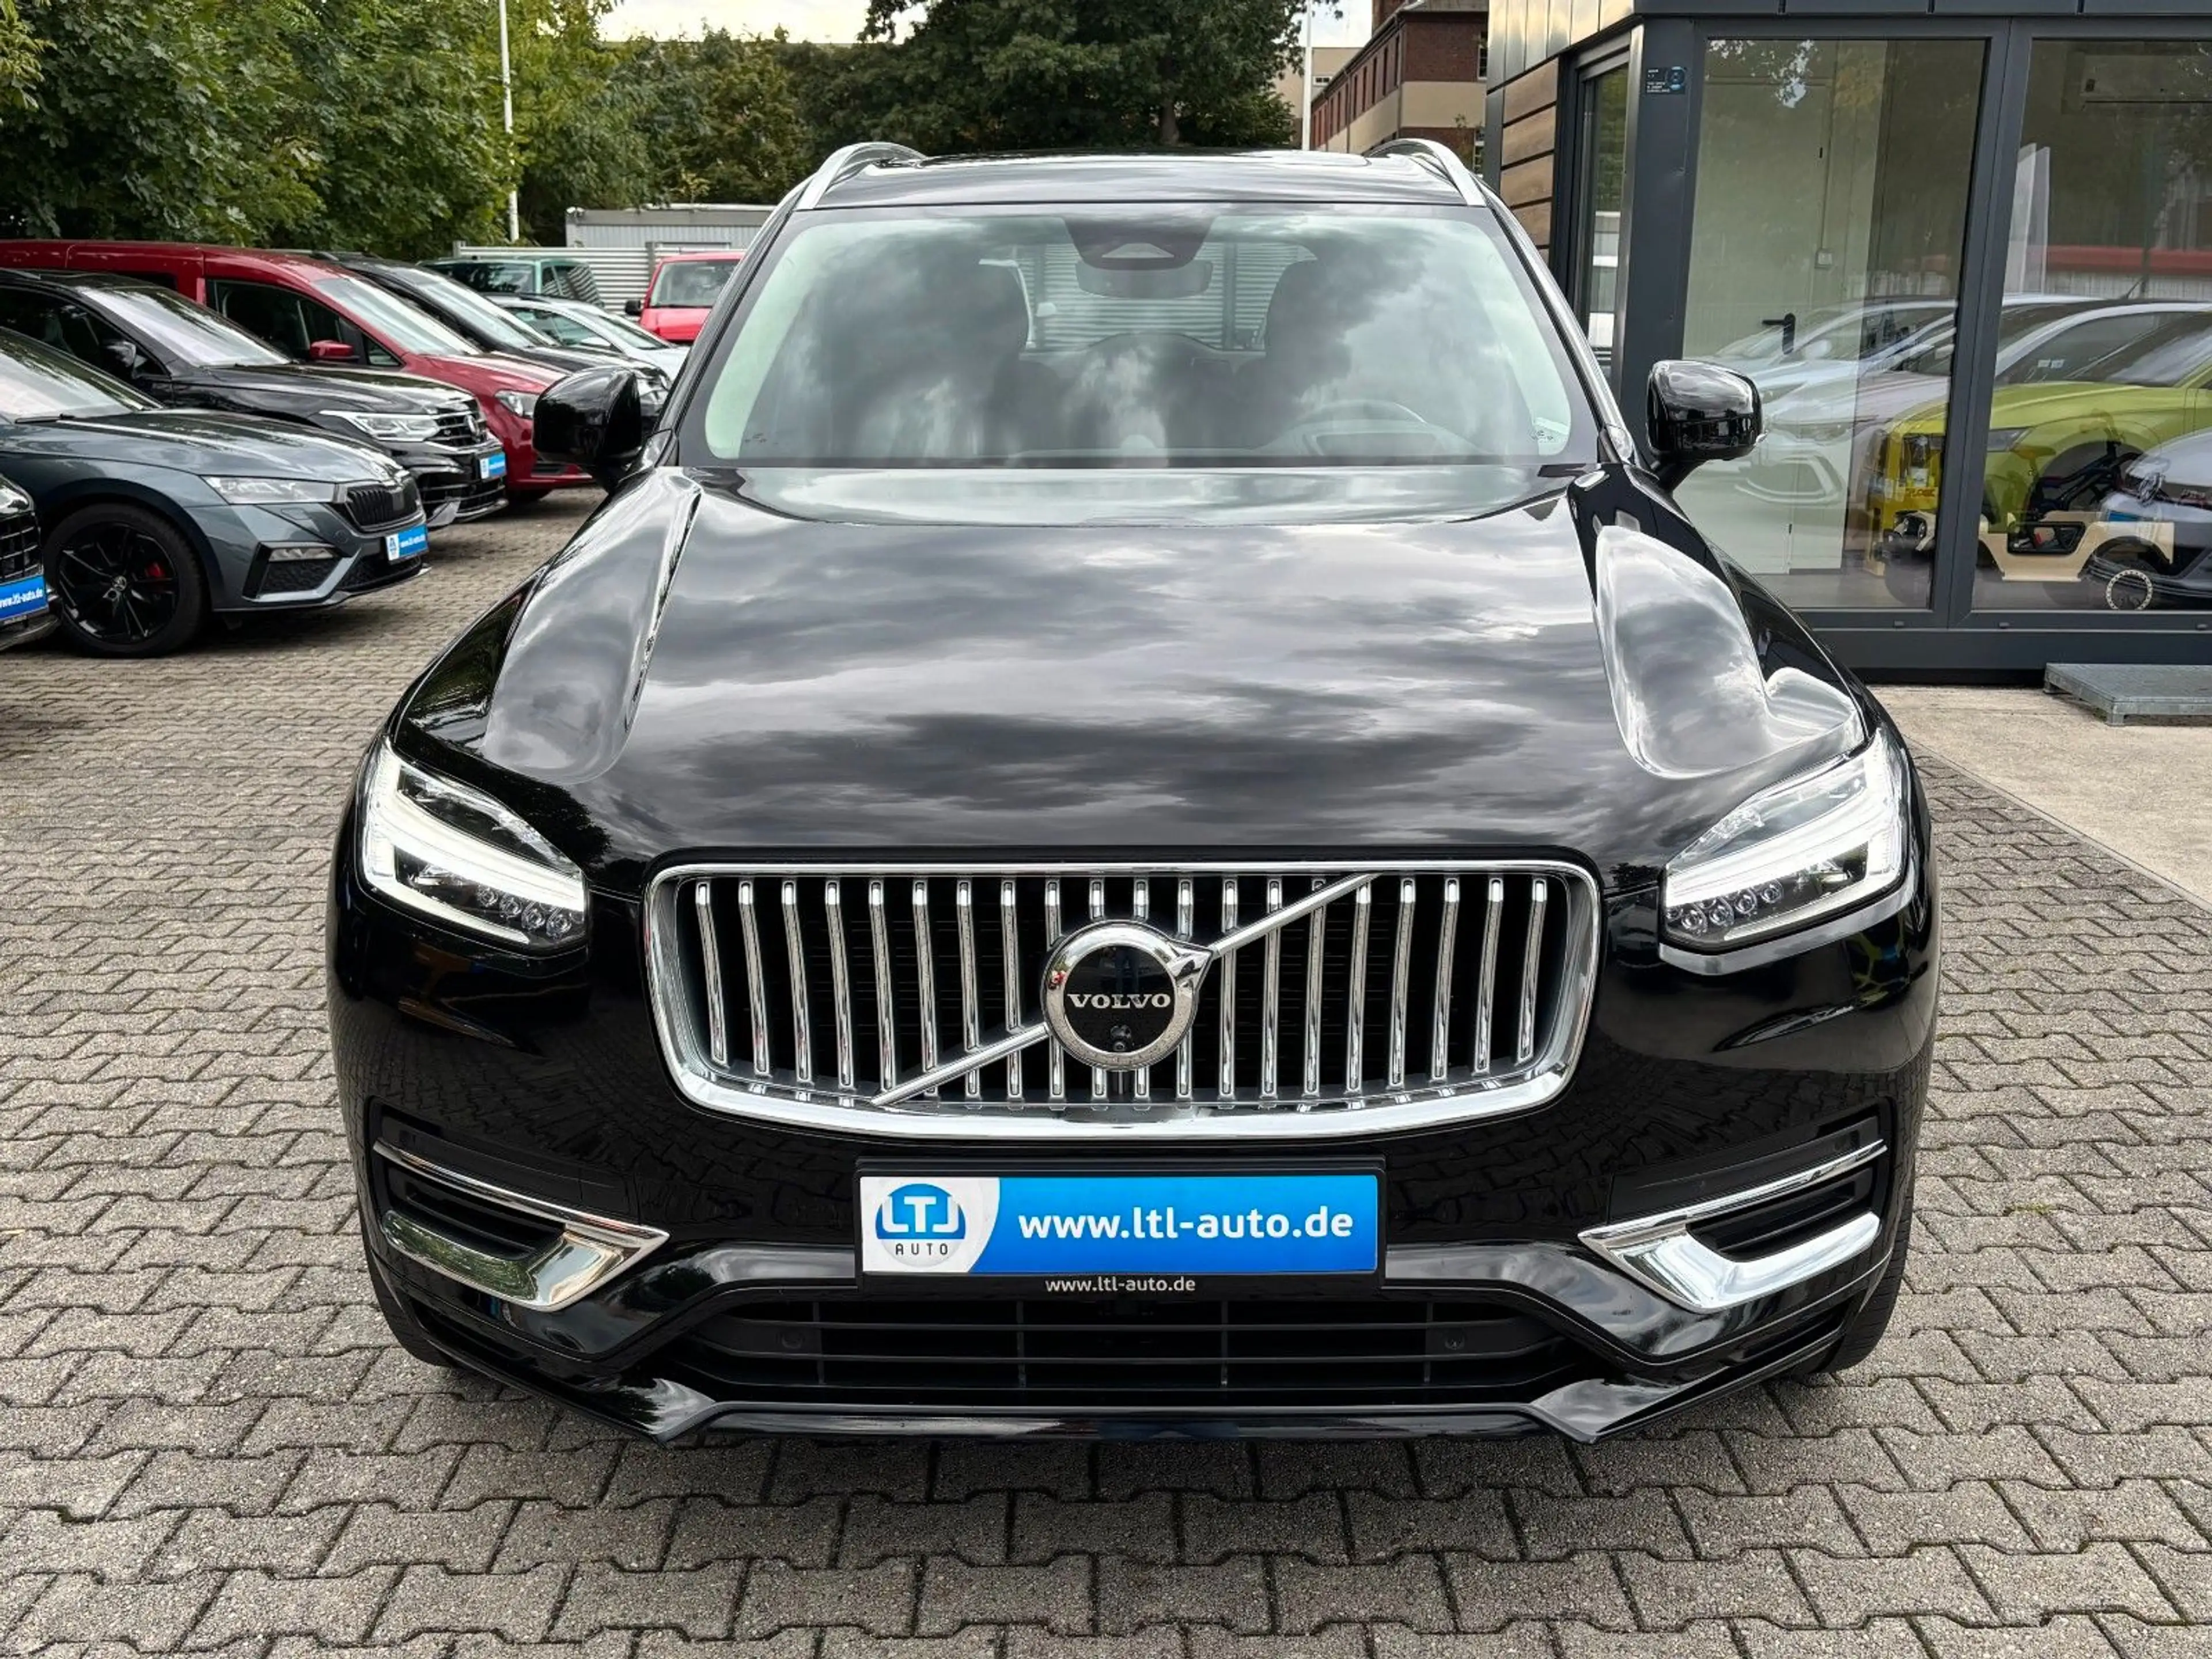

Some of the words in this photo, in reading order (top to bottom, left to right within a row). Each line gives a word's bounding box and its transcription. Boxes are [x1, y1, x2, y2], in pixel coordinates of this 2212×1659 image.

[1067, 993, 1171, 1009] VOLVO
[1018, 1206, 1353, 1238] www.ltl-auto.de
[895, 1243, 949, 1256] AUTO
[1045, 1276, 1196, 1293] www.ltl-auto.de
